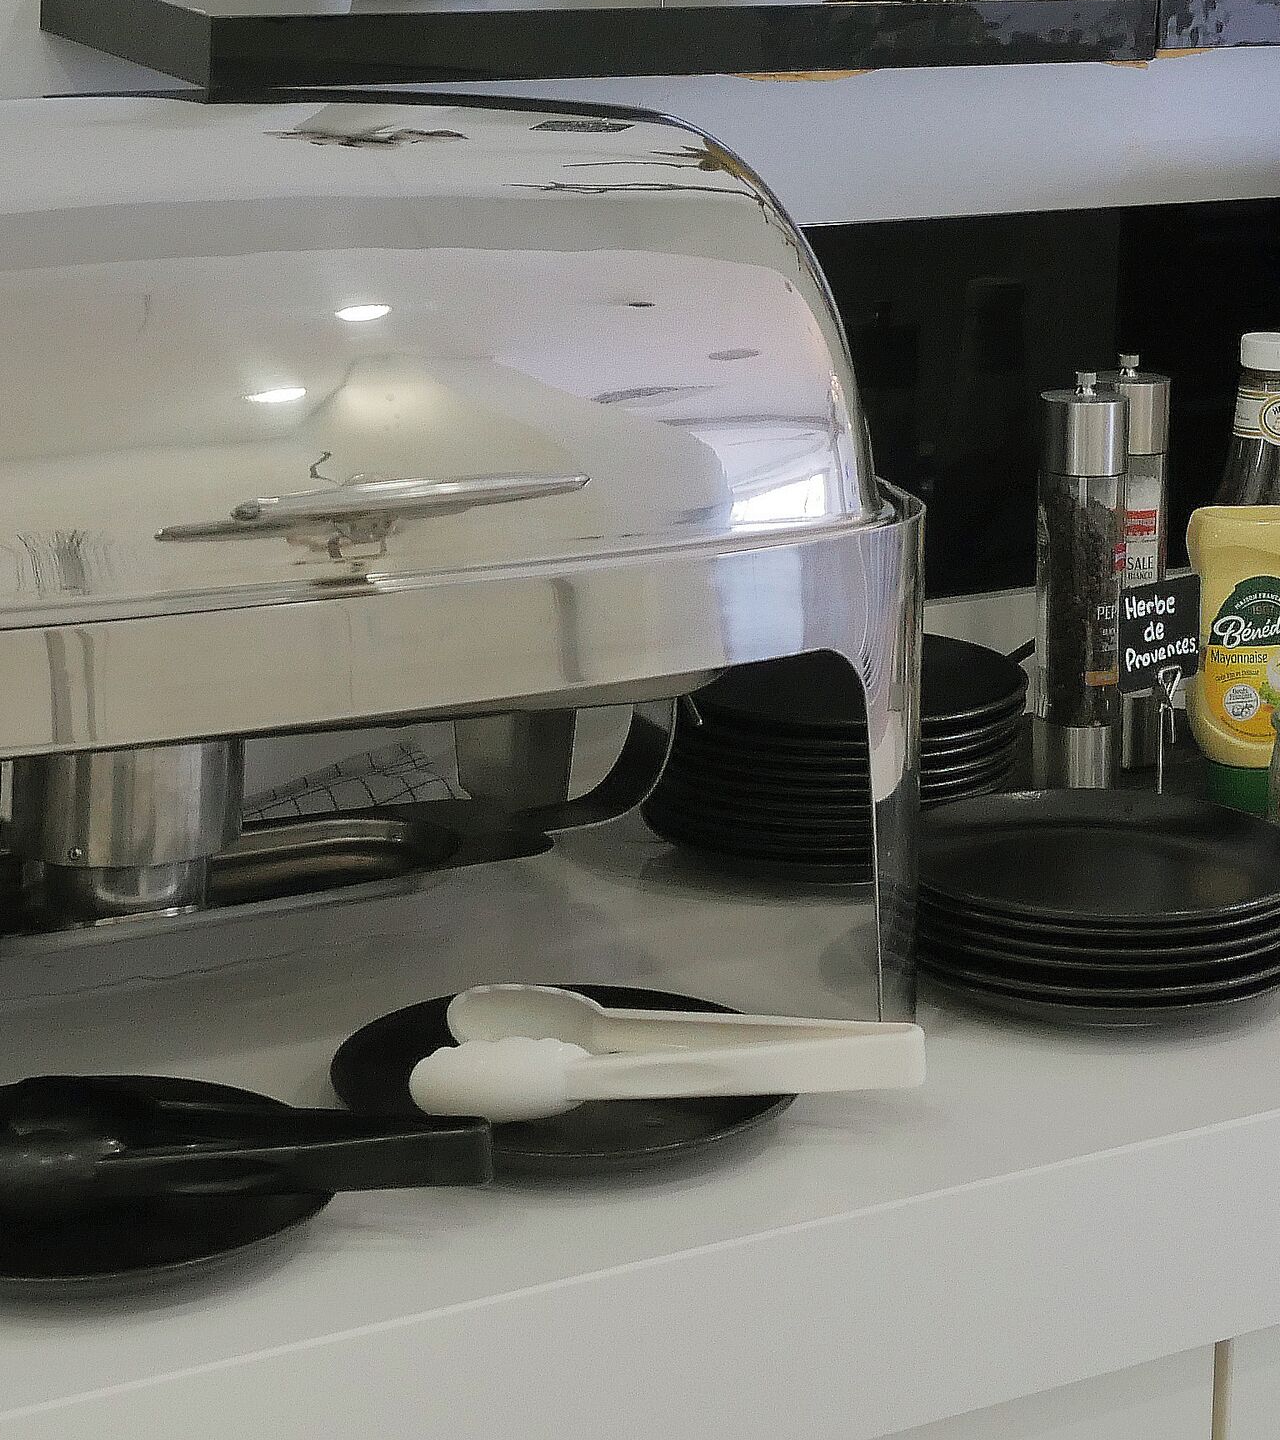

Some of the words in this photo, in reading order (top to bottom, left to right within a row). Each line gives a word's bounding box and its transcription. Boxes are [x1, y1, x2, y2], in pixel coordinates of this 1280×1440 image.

[1127, 555, 1154, 571] SALE
[1125, 595, 1176, 620] Herbe
[1144, 621, 1165, 642] de
[1211, 649, 1268, 668] Mayonnaise
